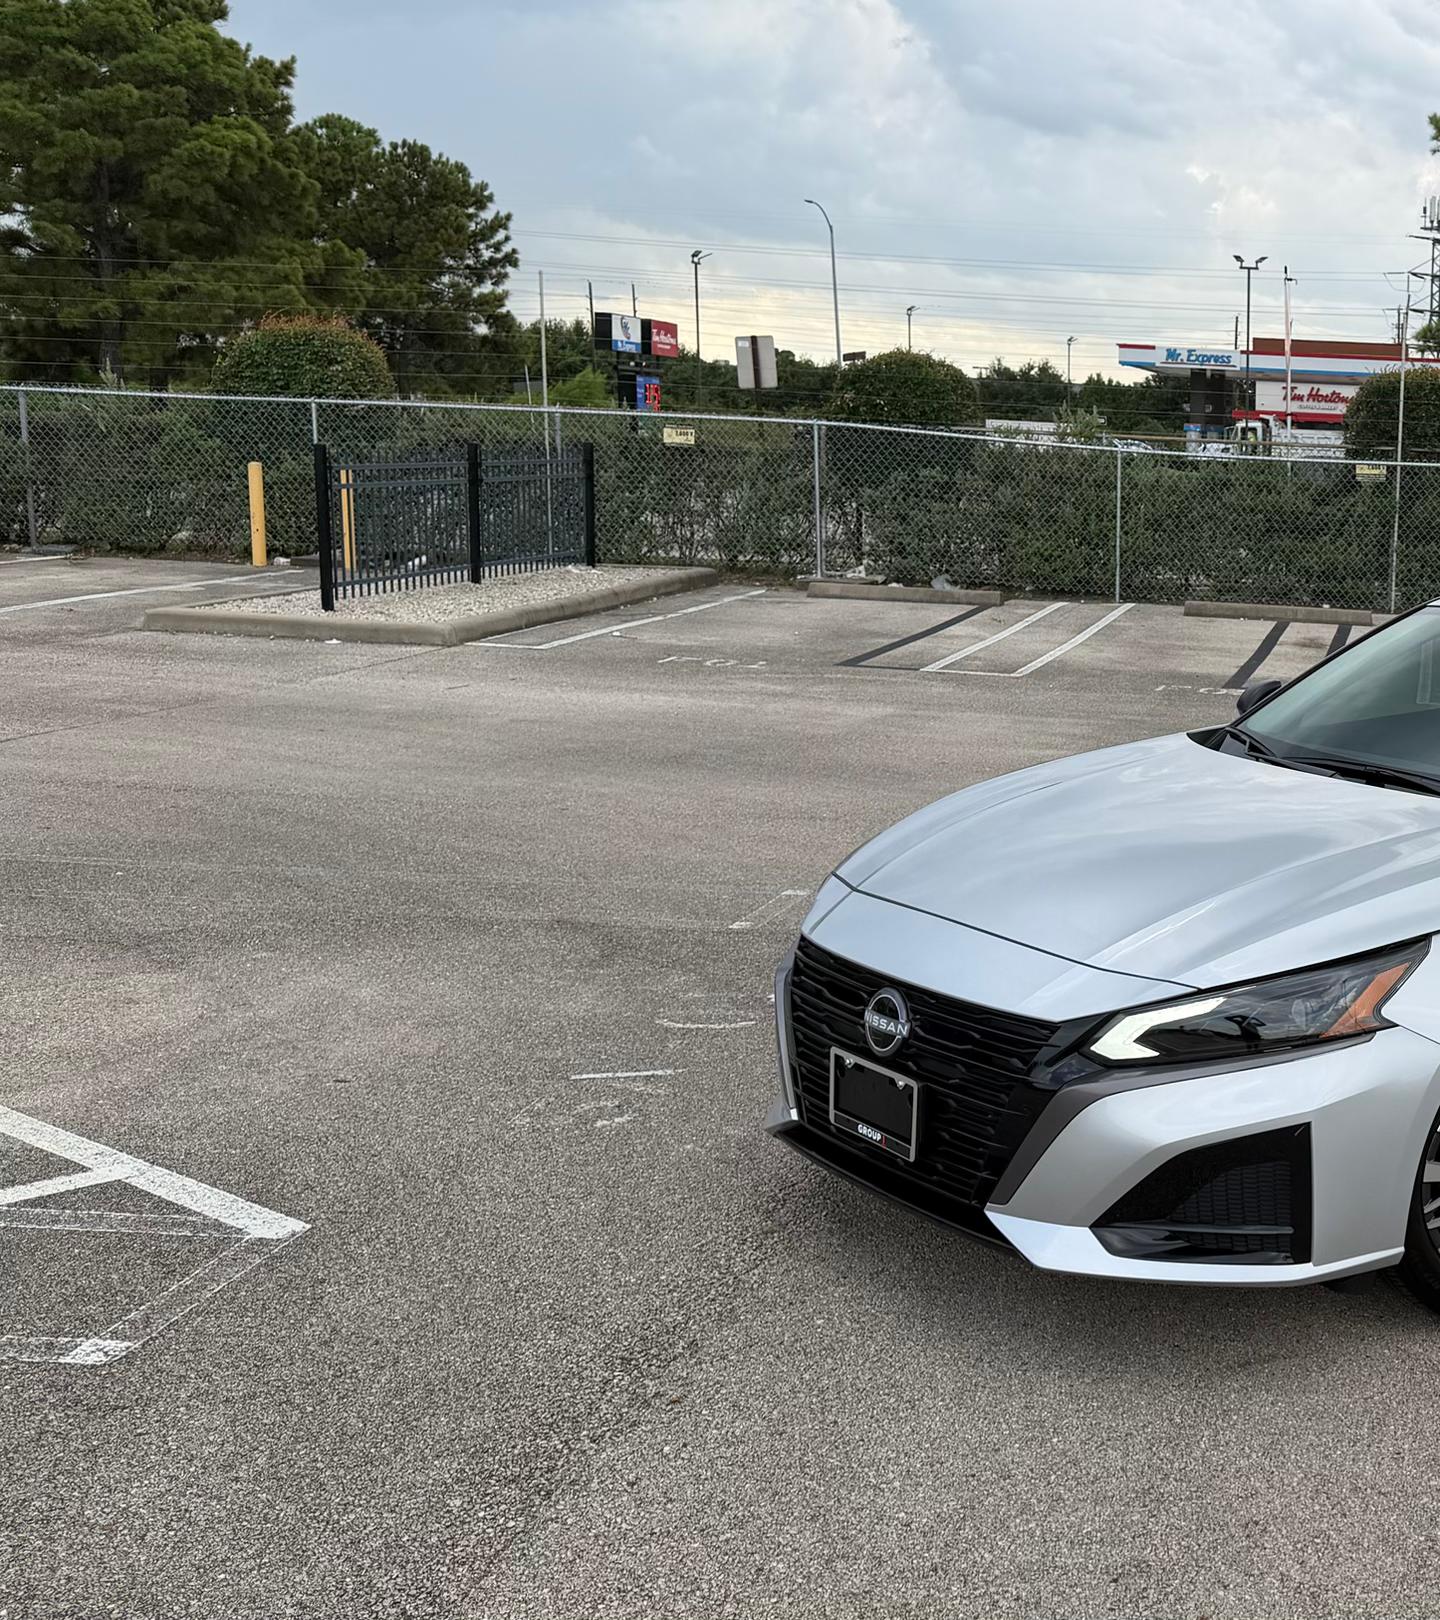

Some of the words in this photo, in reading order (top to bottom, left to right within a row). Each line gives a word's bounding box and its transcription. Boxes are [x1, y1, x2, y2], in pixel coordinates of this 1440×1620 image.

[1165, 348, 1184, 362] Mr.
[1186, 349, 1233, 365] Express
[865, 1009, 908, 1036] NISSAN
[857, 1124, 882, 1142] GROUP
